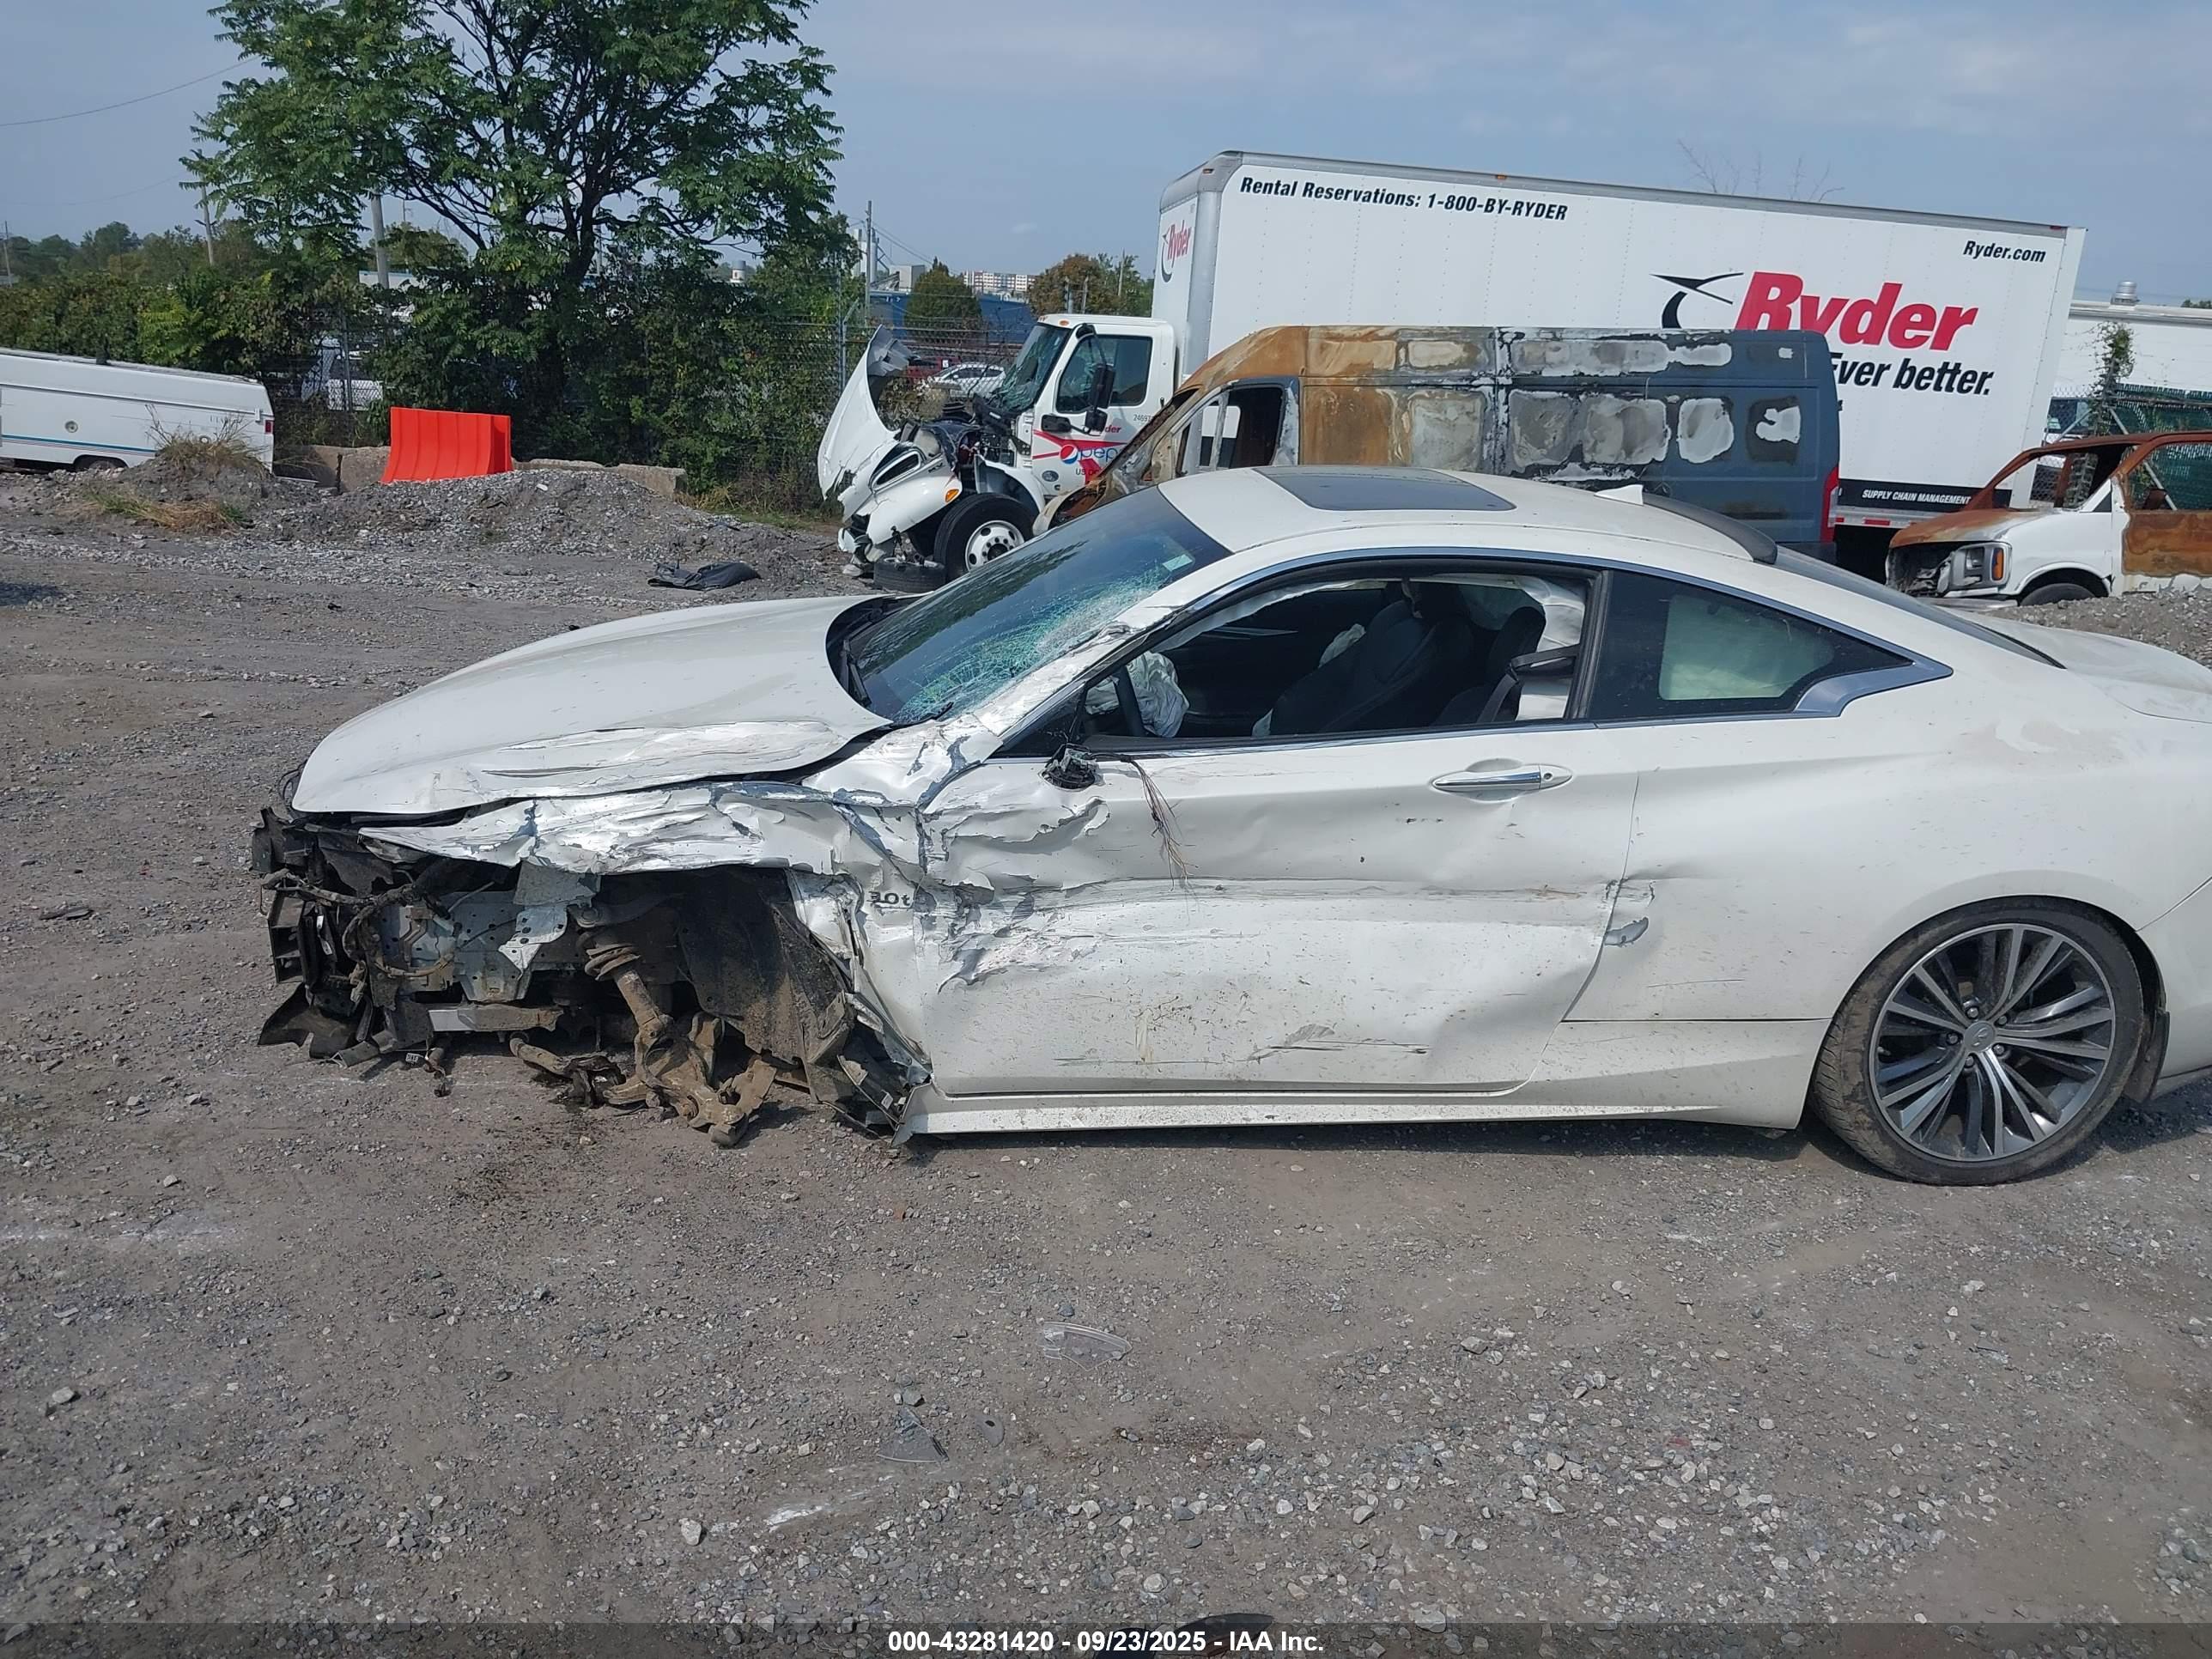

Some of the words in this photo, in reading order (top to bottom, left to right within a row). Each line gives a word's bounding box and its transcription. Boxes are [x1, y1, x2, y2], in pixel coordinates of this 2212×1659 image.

[1240, 177, 1297, 197] Rental
[1303, 182, 1421, 208] Reservations:
[1428, 193, 1567, 220] 1-800-BY-RYDER
[1168, 219, 1192, 268] Ryder
[1963, 240, 2045, 262] Ryder.com
[1735, 271, 1978, 350] Ryder
[1893, 358, 1994, 395] better.
[1080, 447, 1122, 462] pep
[1863, 489, 1892, 500] SUPPLY
[1893, 492, 1916, 501] CHAIN
[1917, 494, 1972, 505] MANAGEMENT
